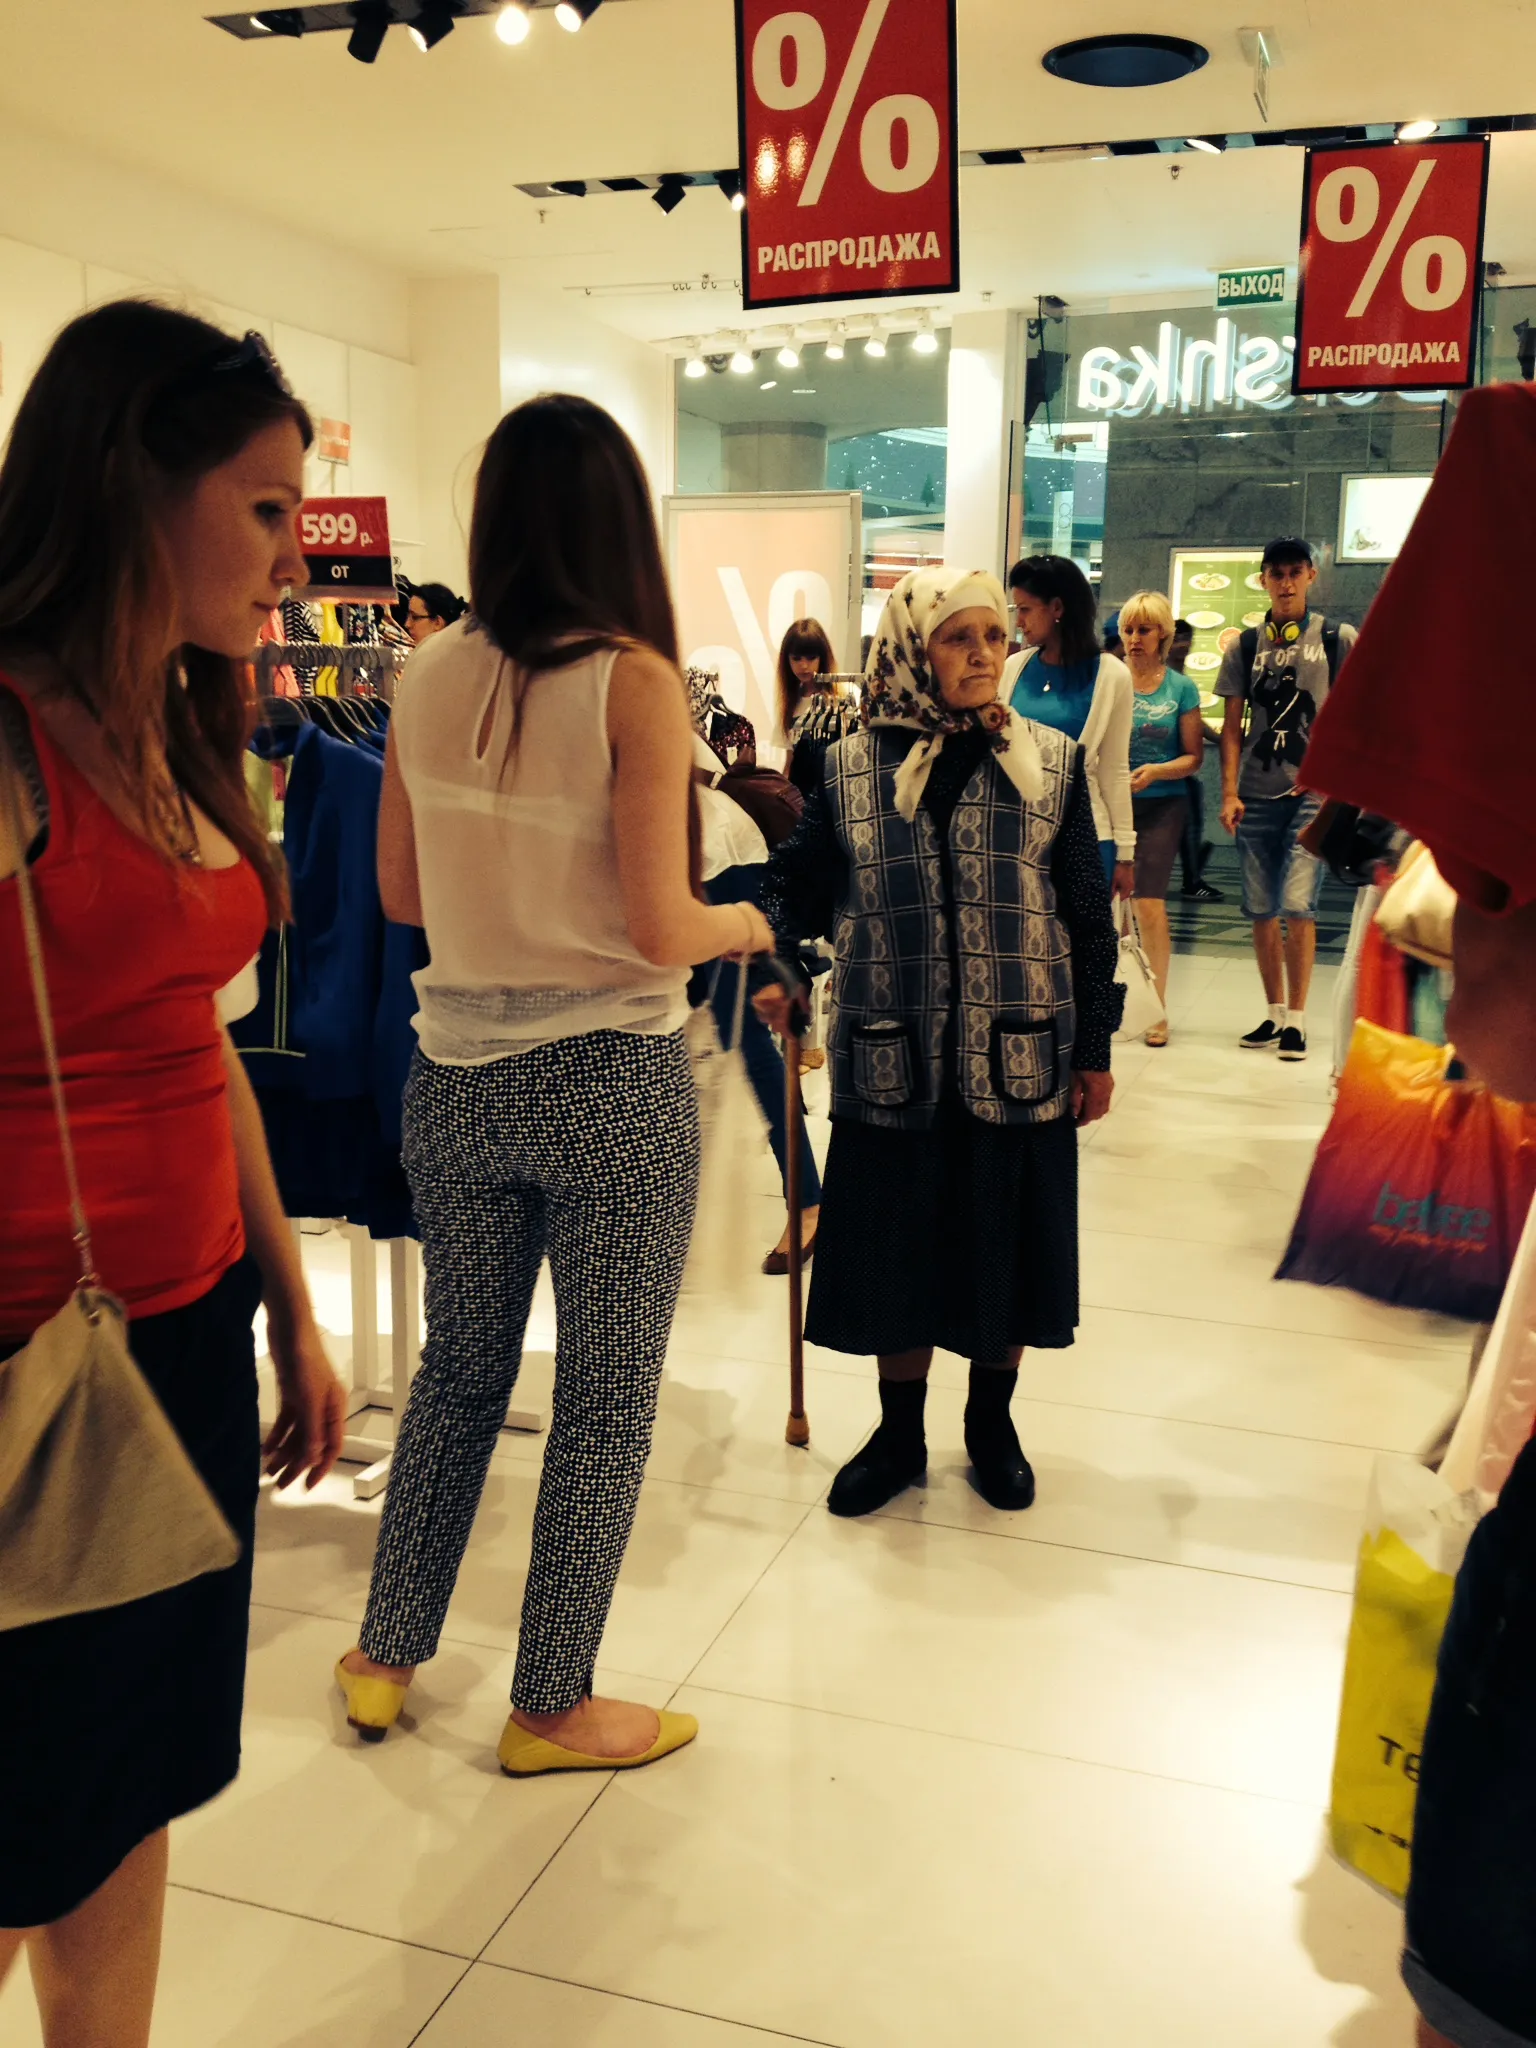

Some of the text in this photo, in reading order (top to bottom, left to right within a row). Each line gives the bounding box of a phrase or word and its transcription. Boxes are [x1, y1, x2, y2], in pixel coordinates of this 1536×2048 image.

[752, 0, 940, 207] %
[758, 231, 941, 273] РАСПРОДАЖА
[1315, 159, 1467, 318] %
[1219, 273, 1284, 297] ВЫХОД
[1307, 341, 1461, 368] РАСПРОДАЖА
[302, 513, 358, 545] 599
[331, 565, 349, 578] ОТ
